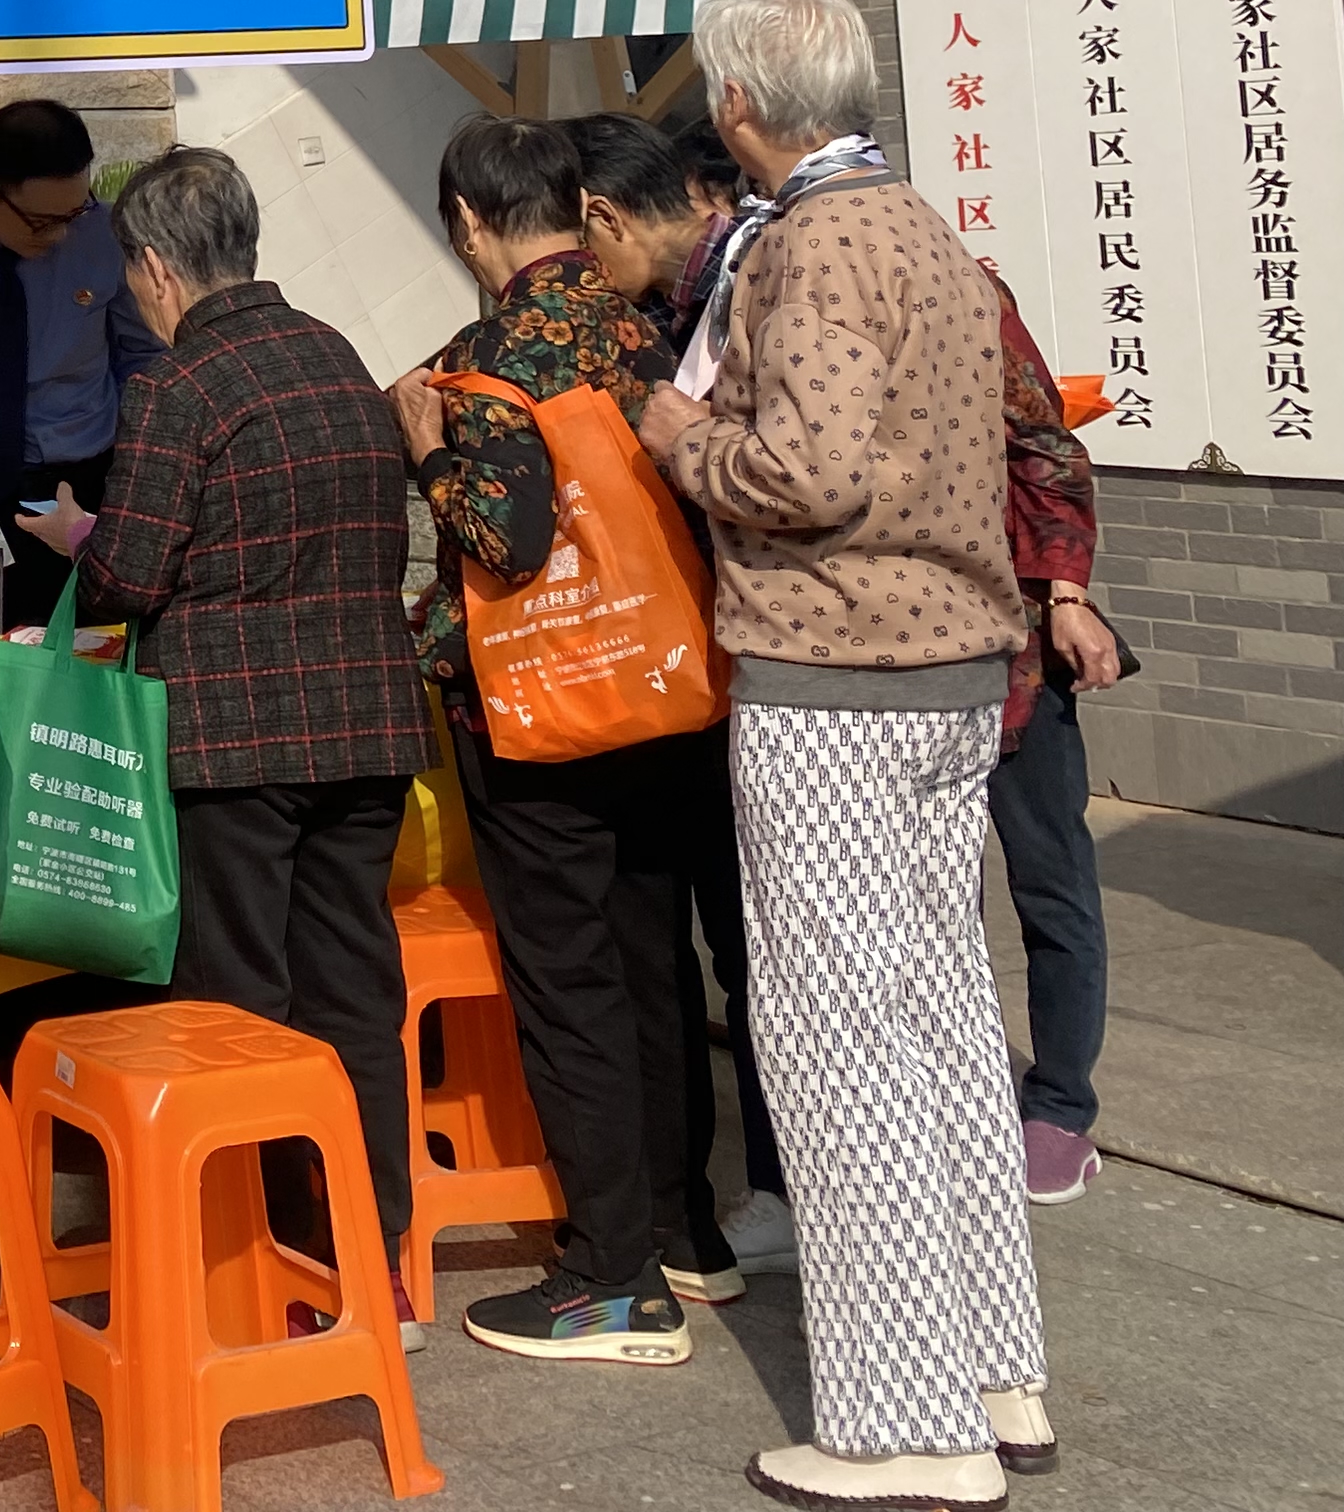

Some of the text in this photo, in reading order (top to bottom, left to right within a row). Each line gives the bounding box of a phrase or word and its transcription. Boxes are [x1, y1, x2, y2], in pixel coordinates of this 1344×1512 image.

[28, 772, 143, 819] 专业验配助听器
[26, 810, 135, 852] 免费试听 免费检查
